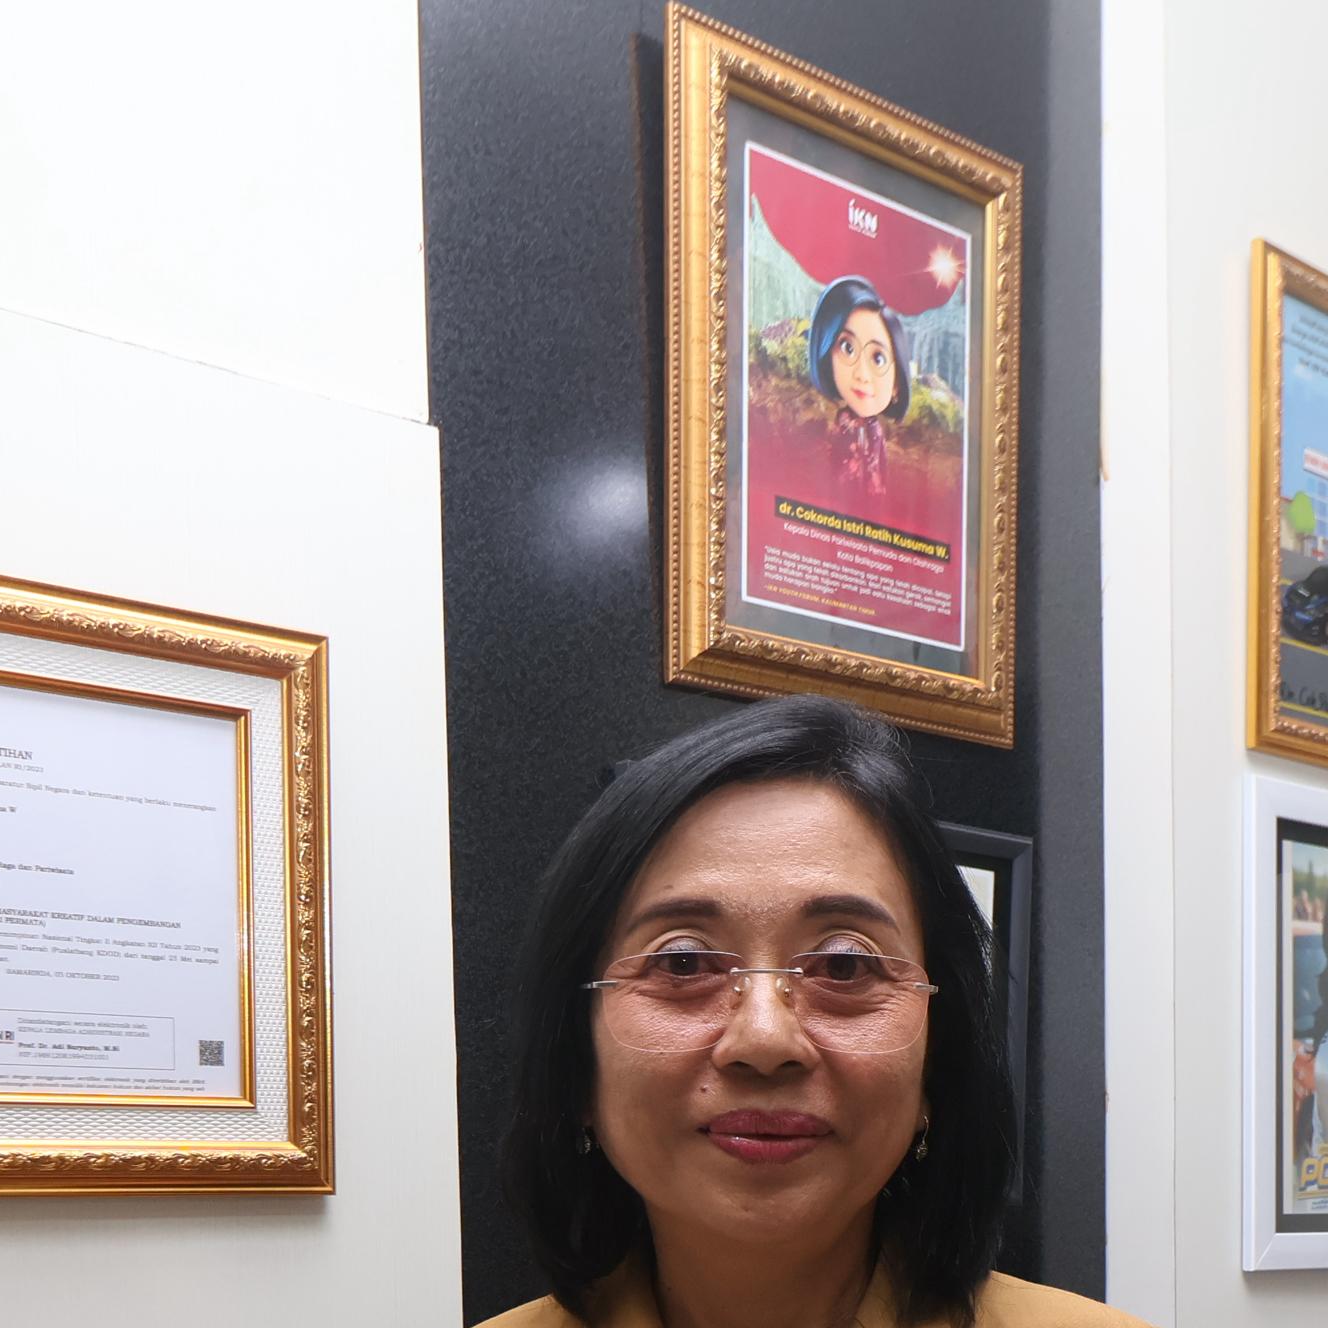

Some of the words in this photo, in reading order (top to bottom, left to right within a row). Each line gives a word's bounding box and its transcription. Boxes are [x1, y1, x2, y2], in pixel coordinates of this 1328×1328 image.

[778, 499, 794, 517] dr.
[795, 504, 841, 530] Cokorda
[842, 517, 863, 536] Istri
[864, 523, 892, 544] Ratih
[892, 532, 934, 556] Kusuma
[5, 1030, 15, 1040] RI
